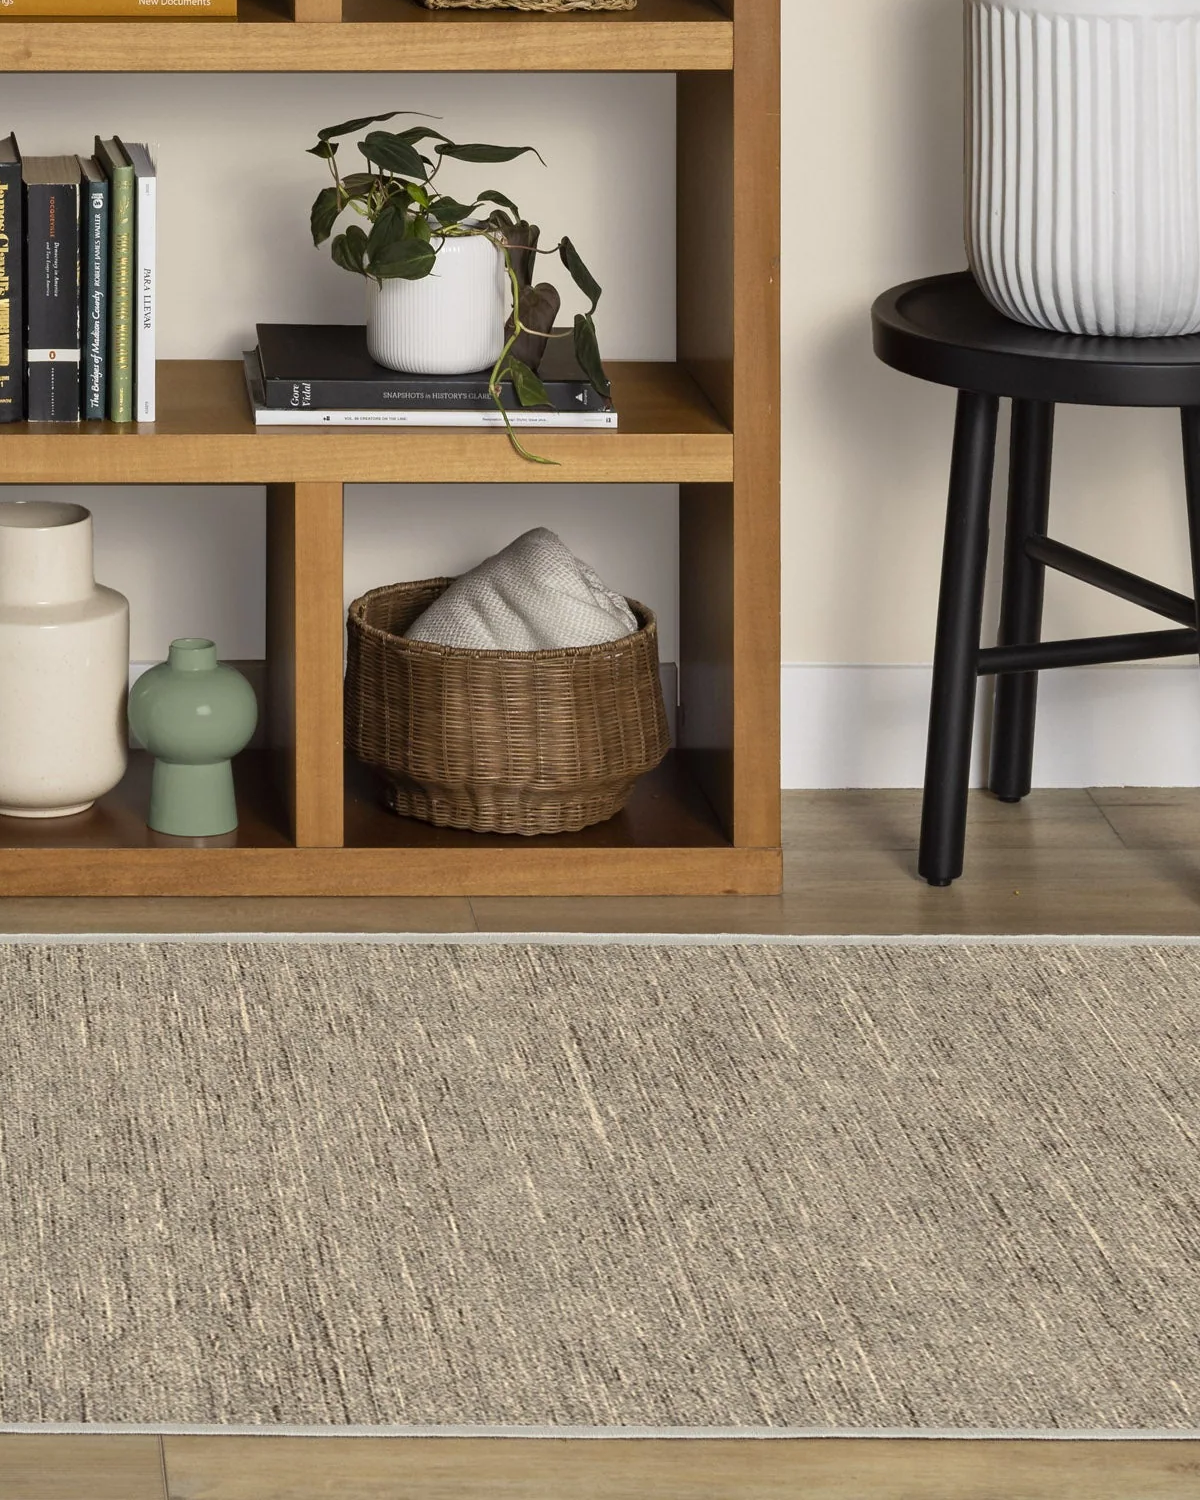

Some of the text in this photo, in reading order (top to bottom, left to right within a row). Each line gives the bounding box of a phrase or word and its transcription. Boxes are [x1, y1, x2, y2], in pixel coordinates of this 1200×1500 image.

[94, 213, 102, 238] WALLER
[52, 242, 60, 269] Democracy
[91, 291, 104, 320] County
[143, 268, 152, 329] PARA LLEVAR
[90, 321, 101, 354] Madison
[90, 354, 103, 364] of
[90, 364, 102, 392] Bridges
[90, 393, 100, 408] The
[290, 382, 300, 407] Gore
[301, 382, 312, 407] Vidal
[382, 391, 424, 399] SNAPSHOTS
[431, 391, 468, 400] HISTORY'S
[468, 392, 492, 400] GLARE
